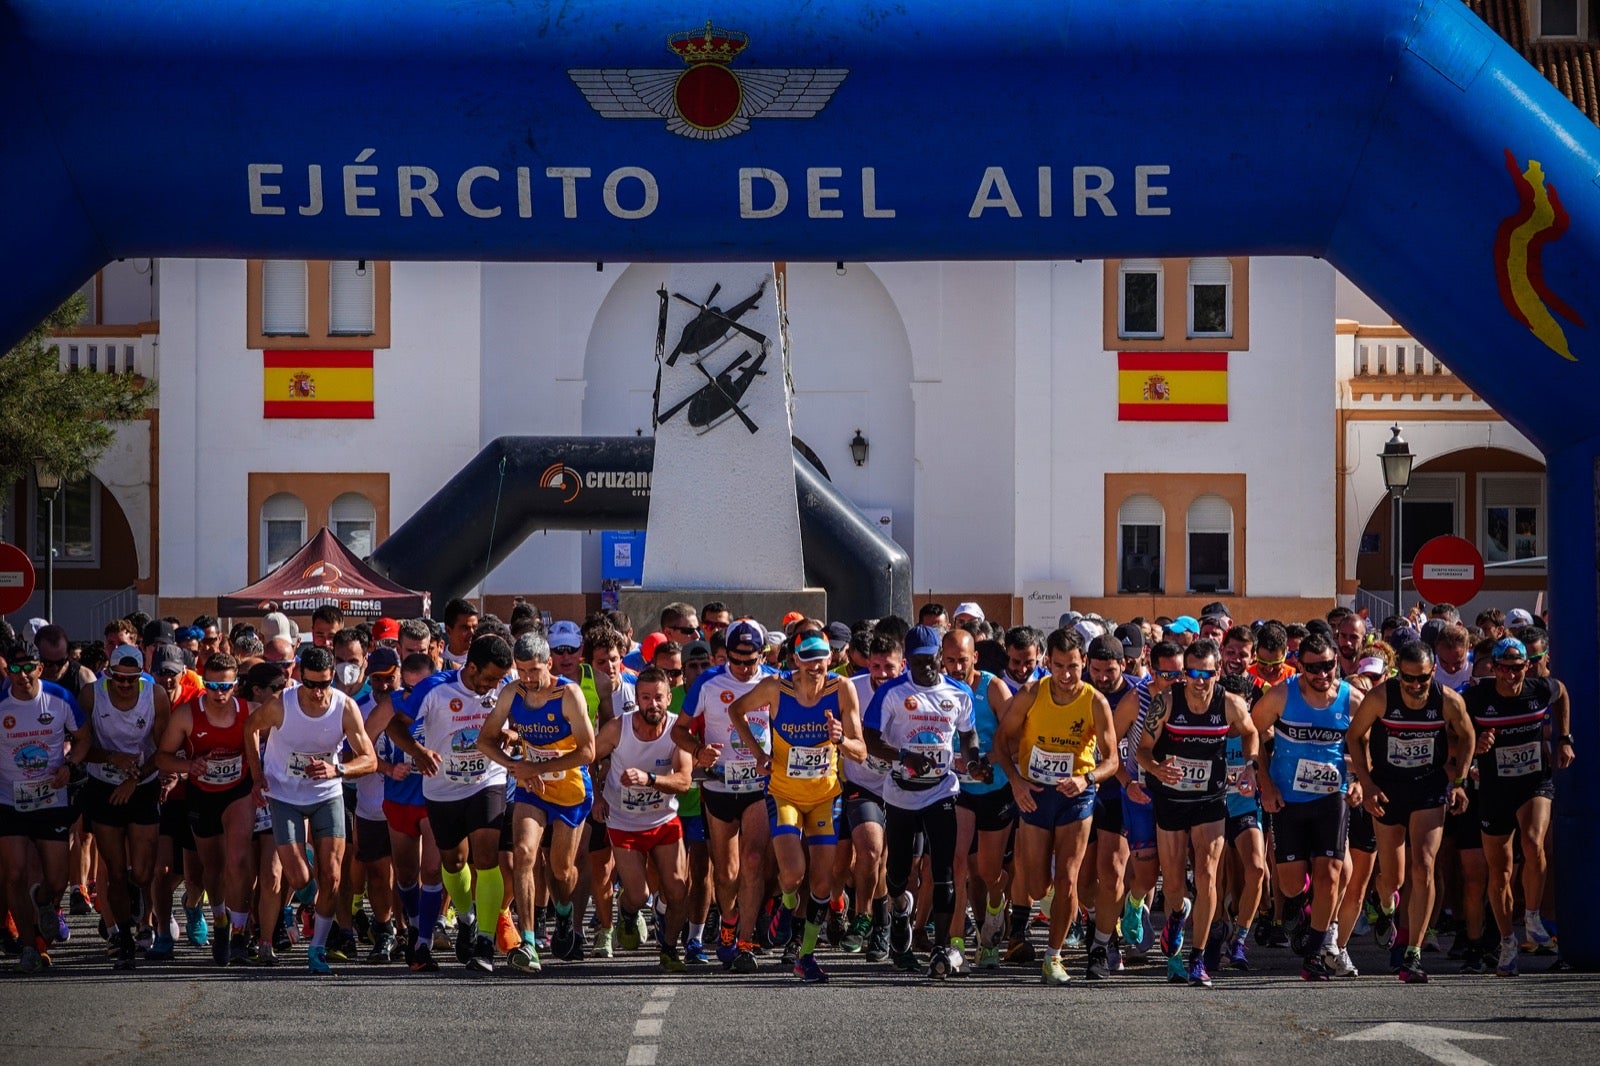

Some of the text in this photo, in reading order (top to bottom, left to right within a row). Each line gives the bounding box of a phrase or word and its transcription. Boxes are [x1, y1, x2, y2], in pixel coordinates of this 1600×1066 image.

[249, 149, 1170, 218] EJÉRCITO DEL AIRE
[1404, 745, 1429, 756] 336
[1512, 749, 1536, 763] 307
[805, 752, 827, 765] 291
[214, 763, 237, 774] 301
[460, 760, 484, 772] 256
[1043, 759, 1068, 773] 270
[742, 767, 759, 779] 20
[1181, 766, 1205, 780] 310
[1313, 769, 1338, 781] 248
[35, 785, 49, 796] 12
[637, 791, 661, 802] 274
